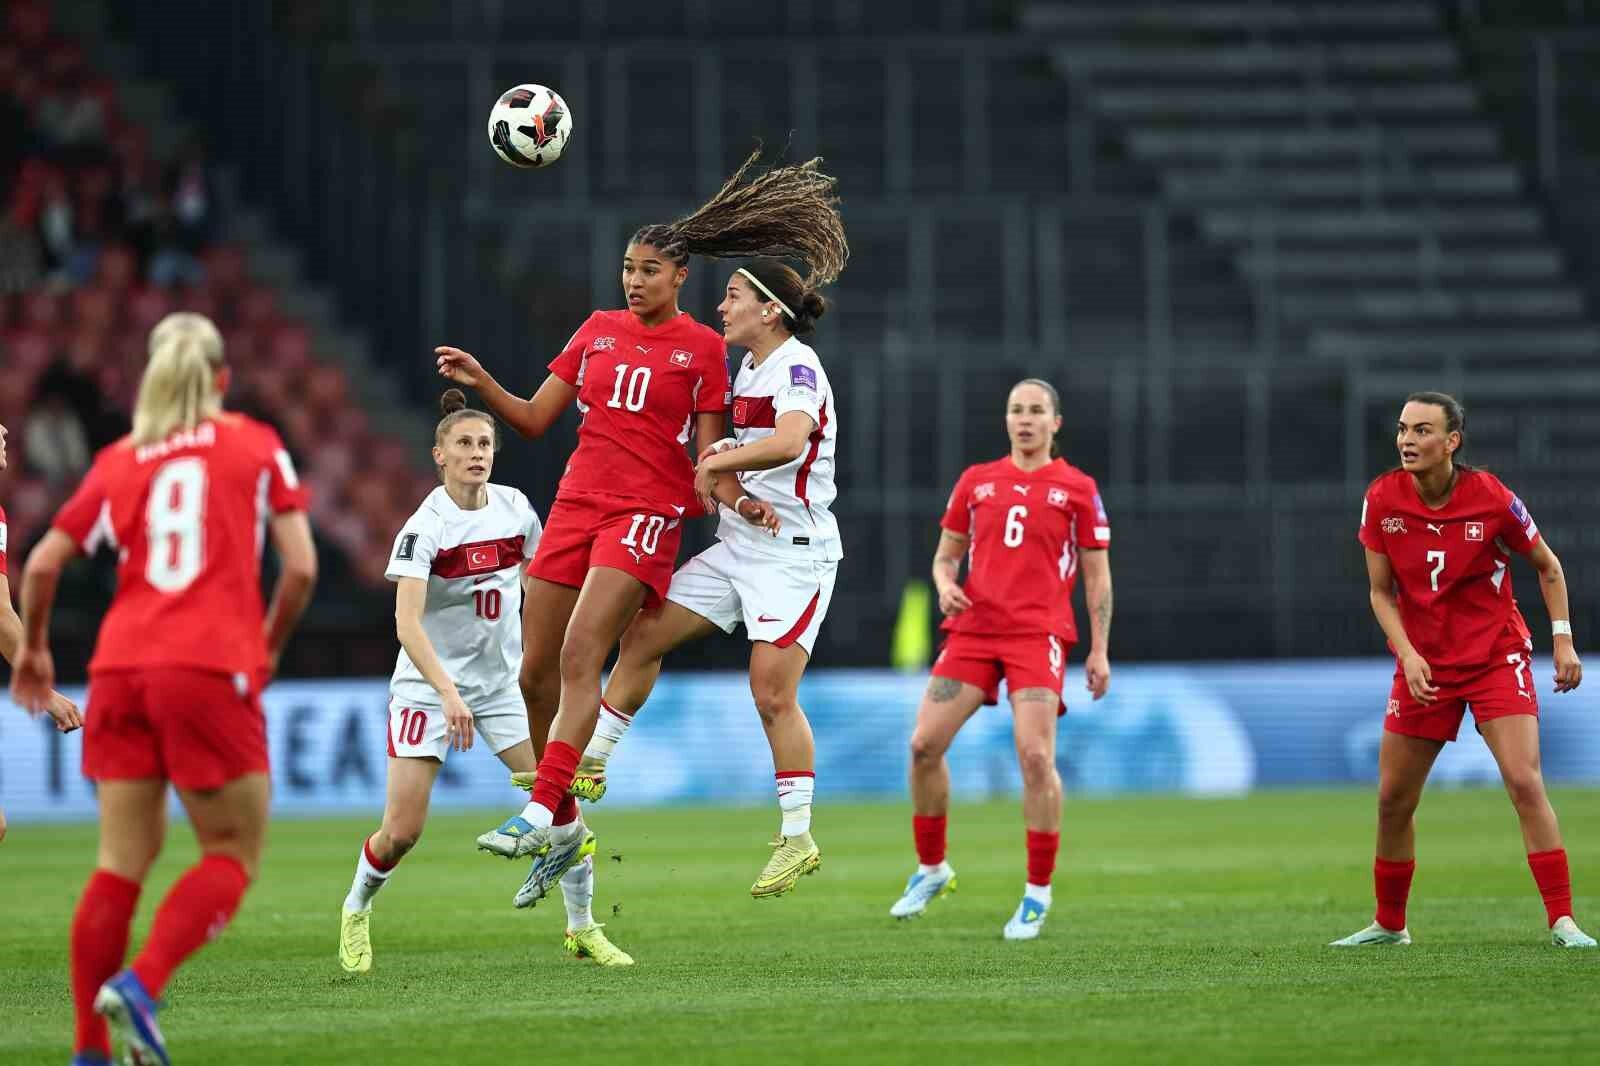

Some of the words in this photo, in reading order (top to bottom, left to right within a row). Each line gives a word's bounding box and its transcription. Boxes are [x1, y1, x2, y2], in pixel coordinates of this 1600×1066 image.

[606, 363, 652, 412] 10
[146, 455, 208, 593] 8
[620, 513, 665, 556] 10
[1004, 505, 1028, 548] 6
[1426, 550, 1446, 592] 7
[473, 588, 501, 621] 10
[1506, 652, 1526, 688] 7
[398, 707, 427, 746] 10
